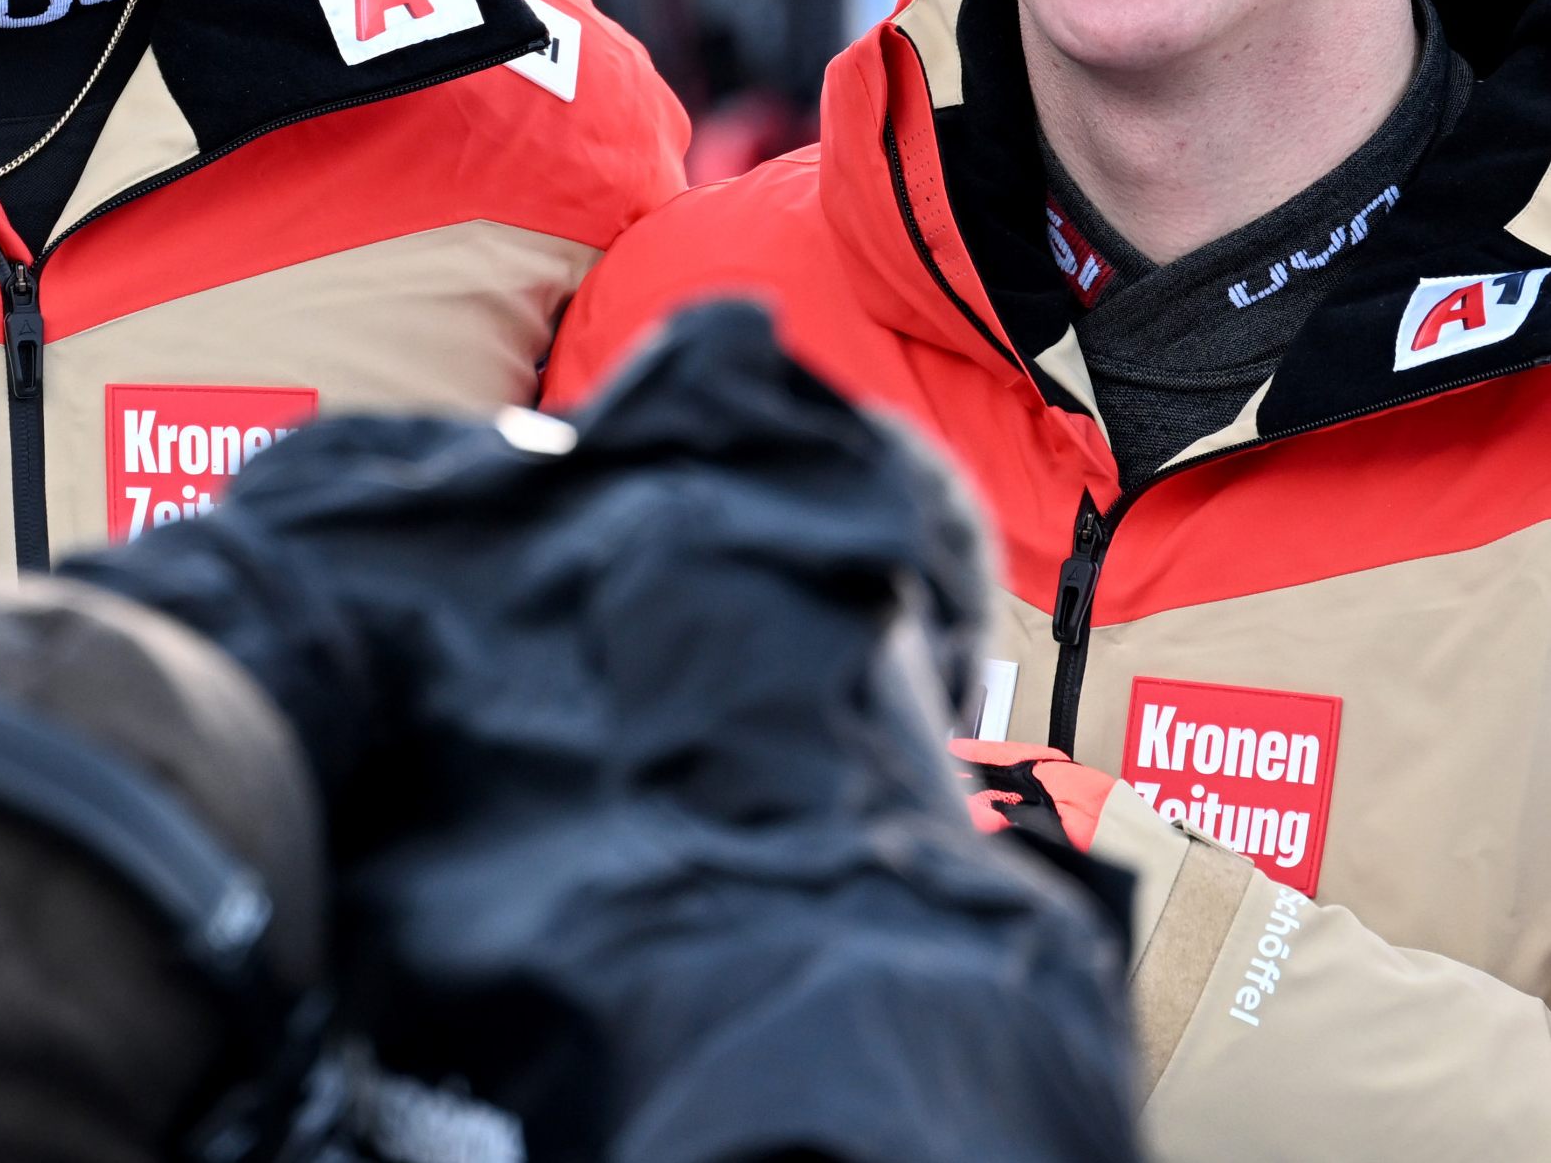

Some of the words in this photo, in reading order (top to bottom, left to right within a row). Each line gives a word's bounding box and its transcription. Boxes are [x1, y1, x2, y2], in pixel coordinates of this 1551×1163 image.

[1411, 270, 1531, 351] A1
[124, 409, 299, 476] Krone
[1137, 704, 1320, 785] Kronen
